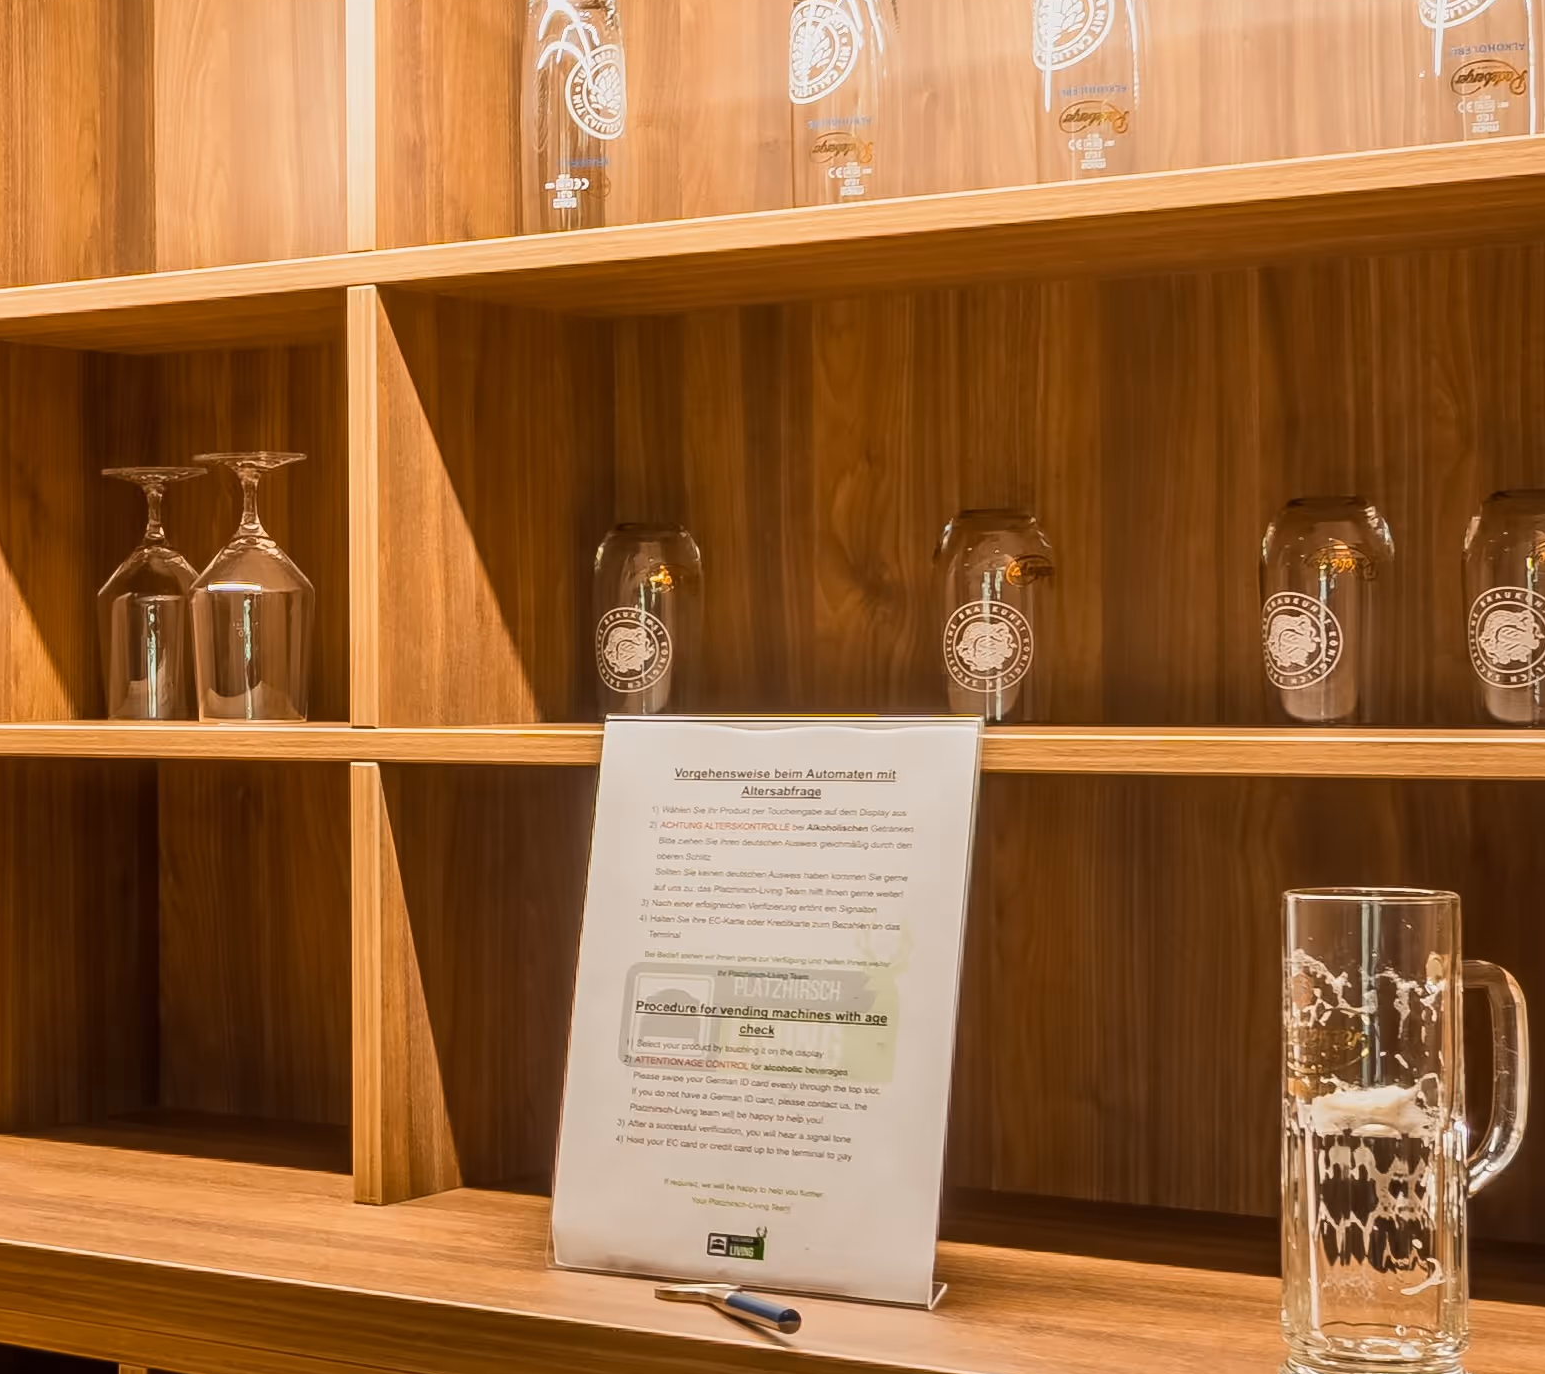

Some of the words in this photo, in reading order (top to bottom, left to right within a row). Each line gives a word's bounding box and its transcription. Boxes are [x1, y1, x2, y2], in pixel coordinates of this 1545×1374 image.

[1453, 67, 1529, 95] Radeberger
[674, 768, 771, 780] Vorgehensweise
[774, 768, 803, 779] beim
[806, 768, 873, 779] Automaten
[876, 769, 897, 779] mit
[740, 786, 822, 798] Altersabfrage
[733, 977, 842, 1002] PLATZHIRSCH
[635, 1001, 698, 1014] Procedure
[699, 1004, 718, 1015] for
[720, 1006, 769, 1019] vending
[771, 1008, 831, 1020] machines
[835, 1010, 862, 1021] with
[864, 1014, 888, 1024] age
[739, 1024, 775, 1034] check
